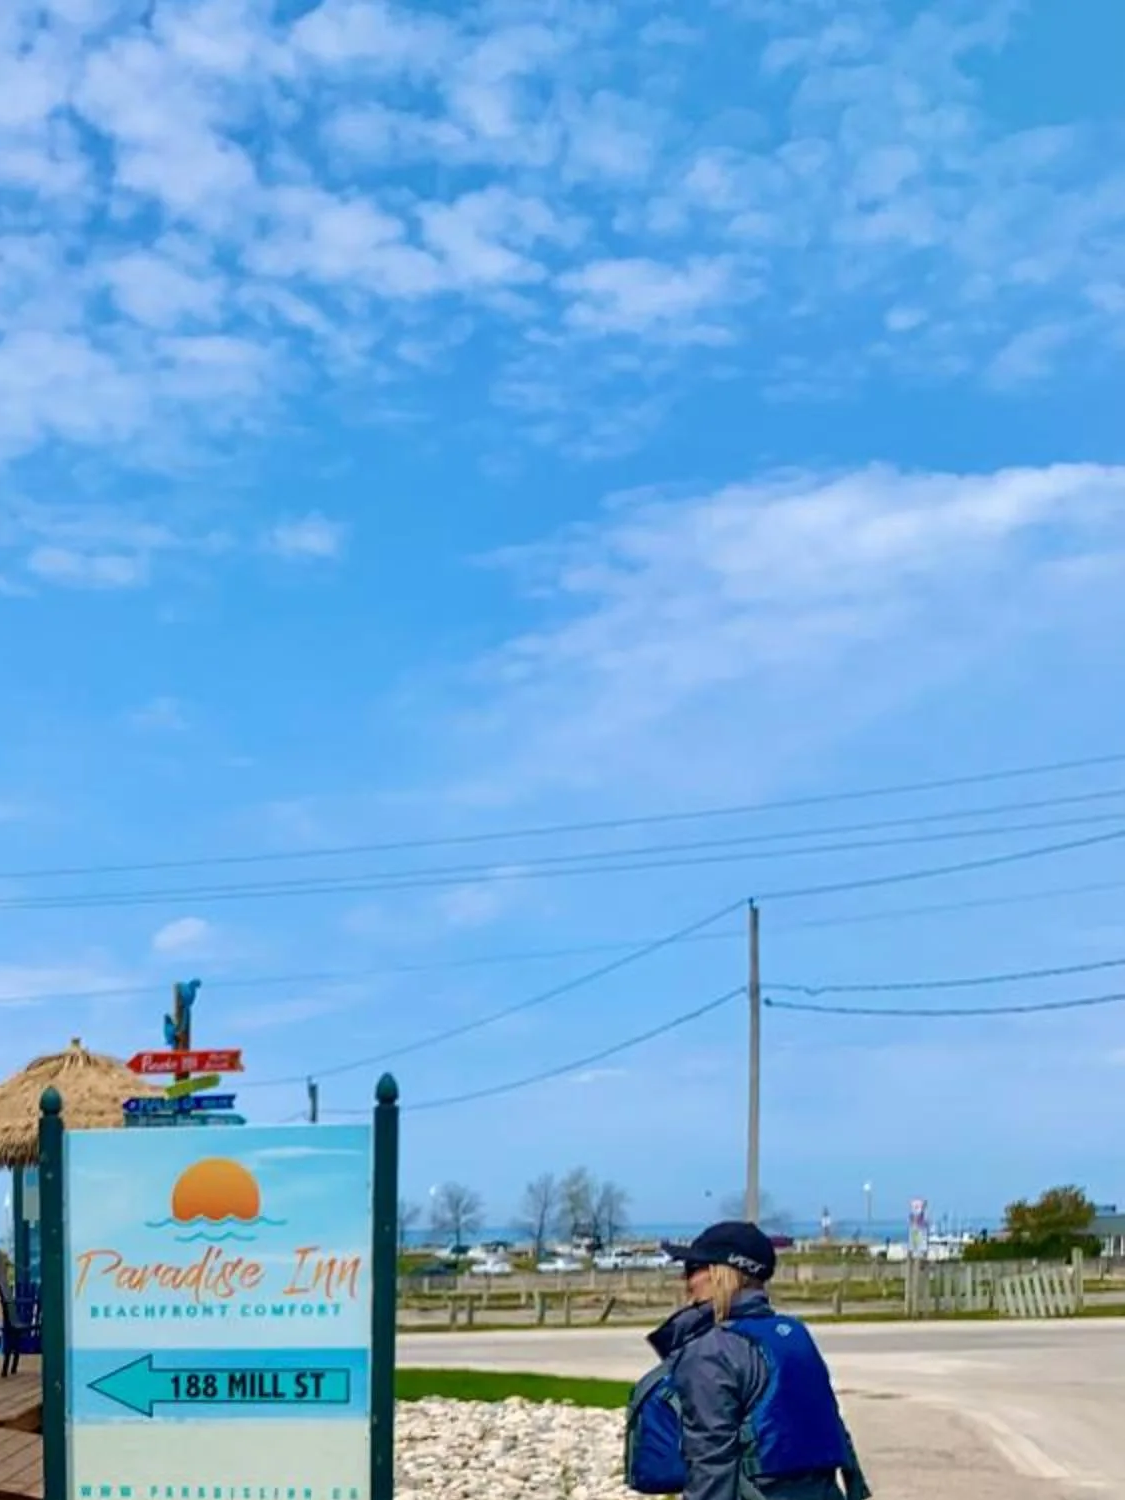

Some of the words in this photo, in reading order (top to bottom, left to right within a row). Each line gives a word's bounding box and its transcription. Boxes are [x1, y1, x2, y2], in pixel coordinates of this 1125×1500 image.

[76, 1246, 266, 1302] Paradise
[283, 1246, 363, 1298] Inn
[90, 1303, 229, 1319] BEACHFRONT
[239, 1302, 342, 1317] COMFORT
[170, 1374, 219, 1399] 188
[228, 1373, 286, 1398] MILL
[294, 1372, 325, 1398] ST
